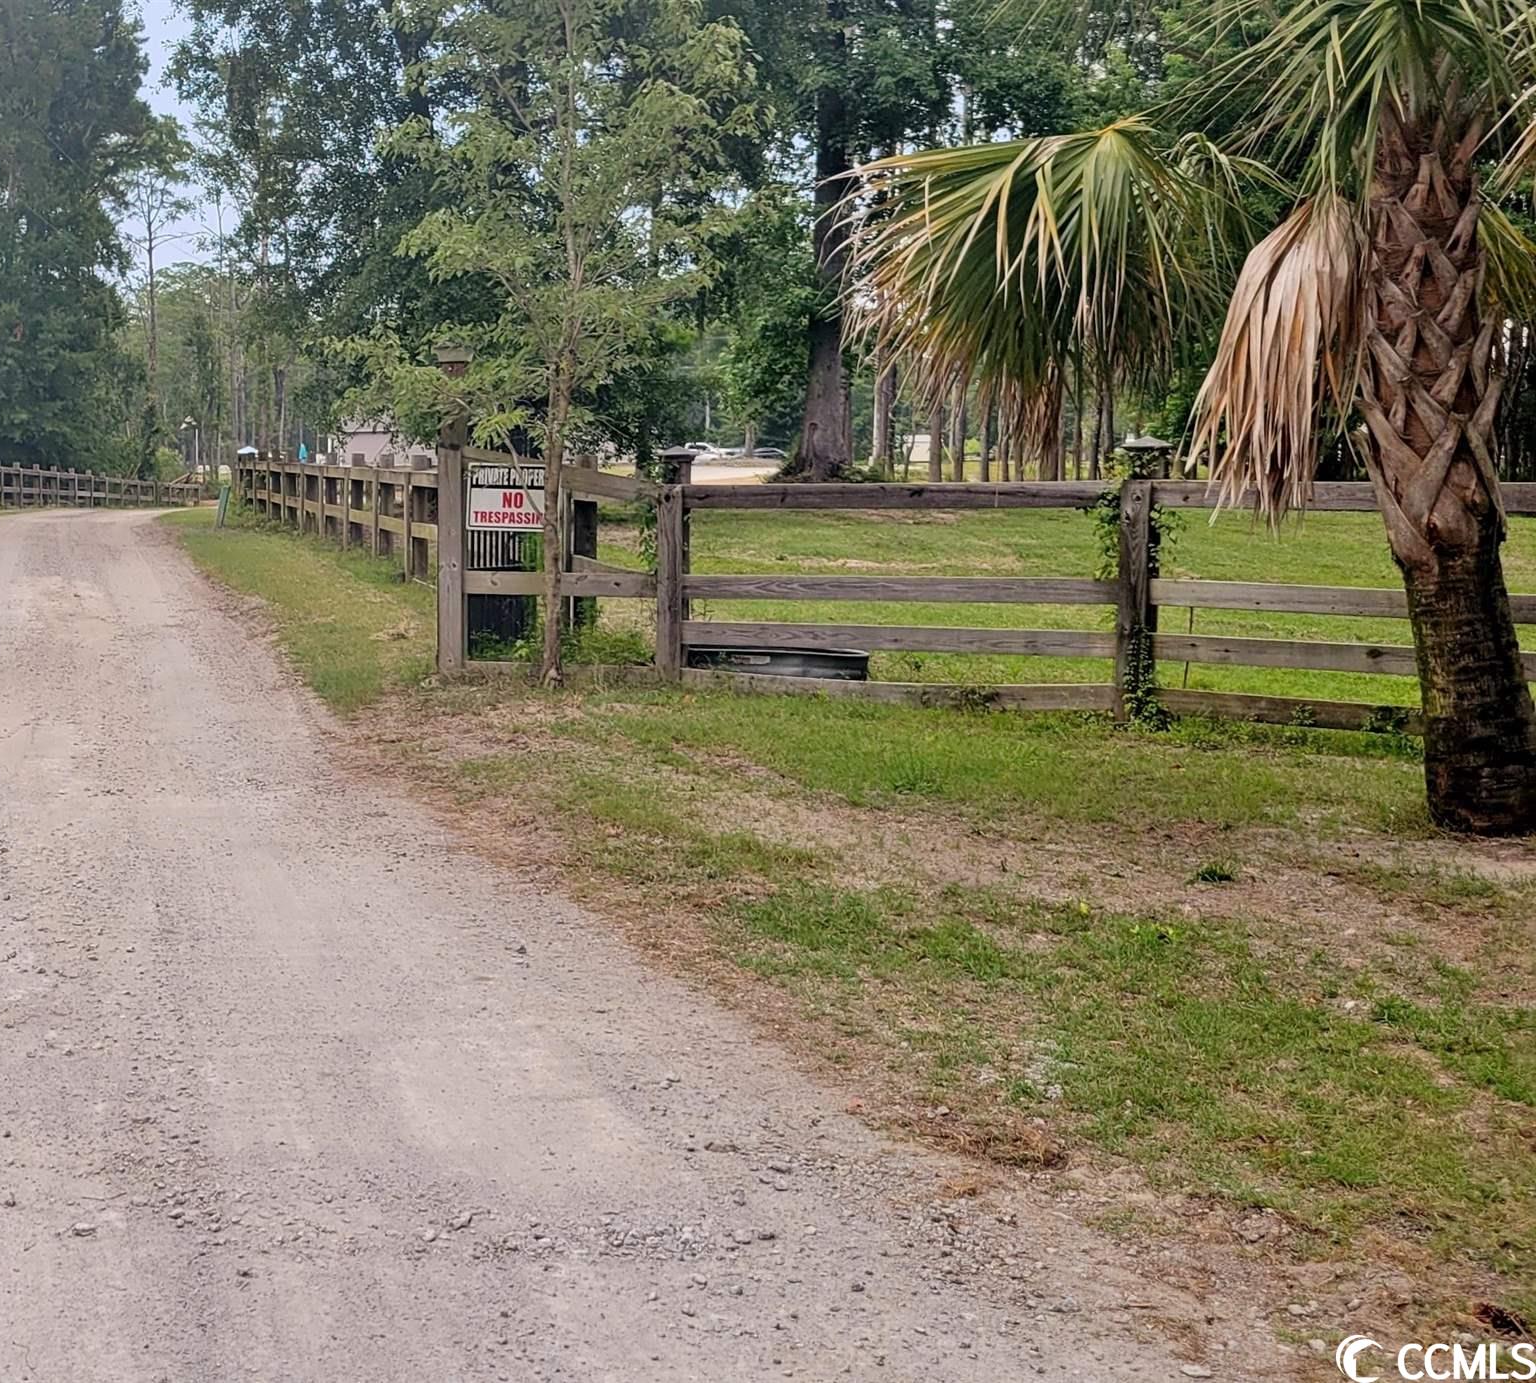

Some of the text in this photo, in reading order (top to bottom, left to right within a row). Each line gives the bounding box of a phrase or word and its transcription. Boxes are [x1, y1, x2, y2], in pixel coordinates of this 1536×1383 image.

[472, 467, 509, 486] PRIVATE
[502, 492, 524, 509] NO
[473, 511, 544, 525] TRESPASSIN
